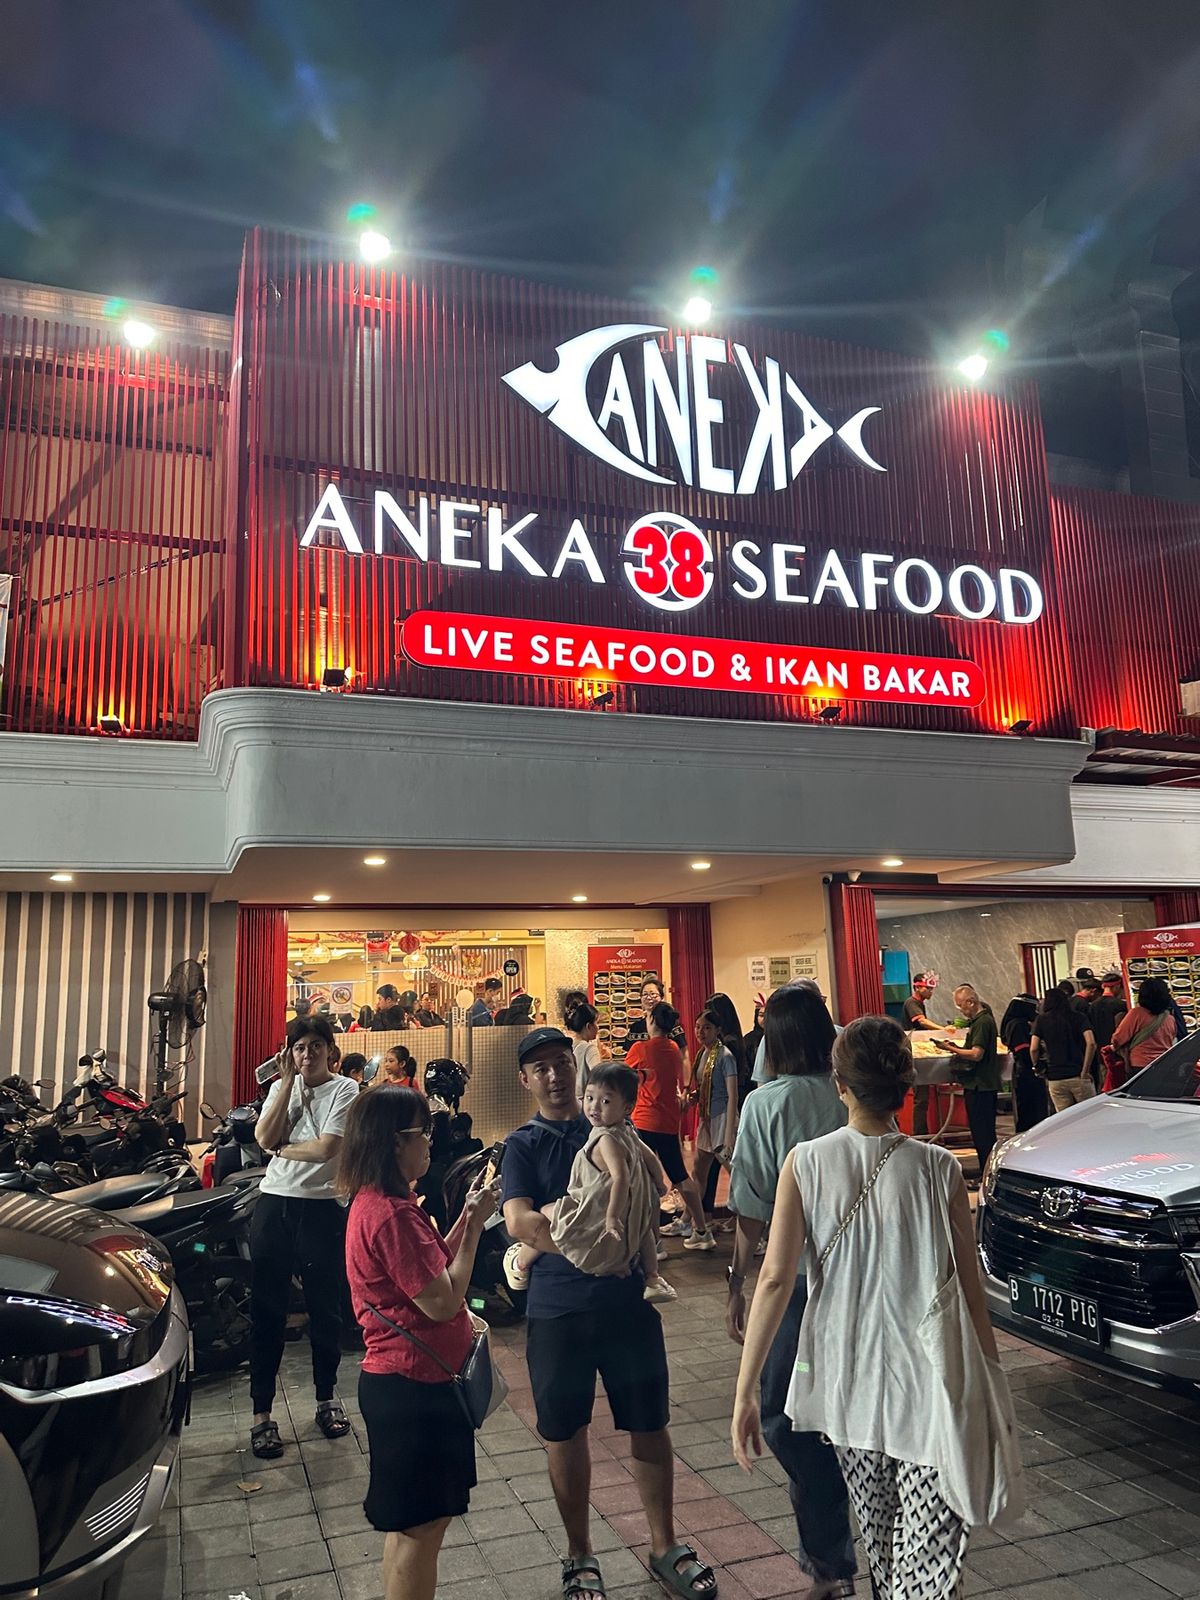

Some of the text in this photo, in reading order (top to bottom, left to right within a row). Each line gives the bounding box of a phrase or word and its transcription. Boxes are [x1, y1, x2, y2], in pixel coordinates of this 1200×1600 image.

[299, 482, 1044, 625] ANEKA 38 SEAFOOD
[424, 624, 971, 698] LIVE SEAFOOD & IKAN BAKAR
[1011, 1279, 1097, 1328] B 1712 PIG
